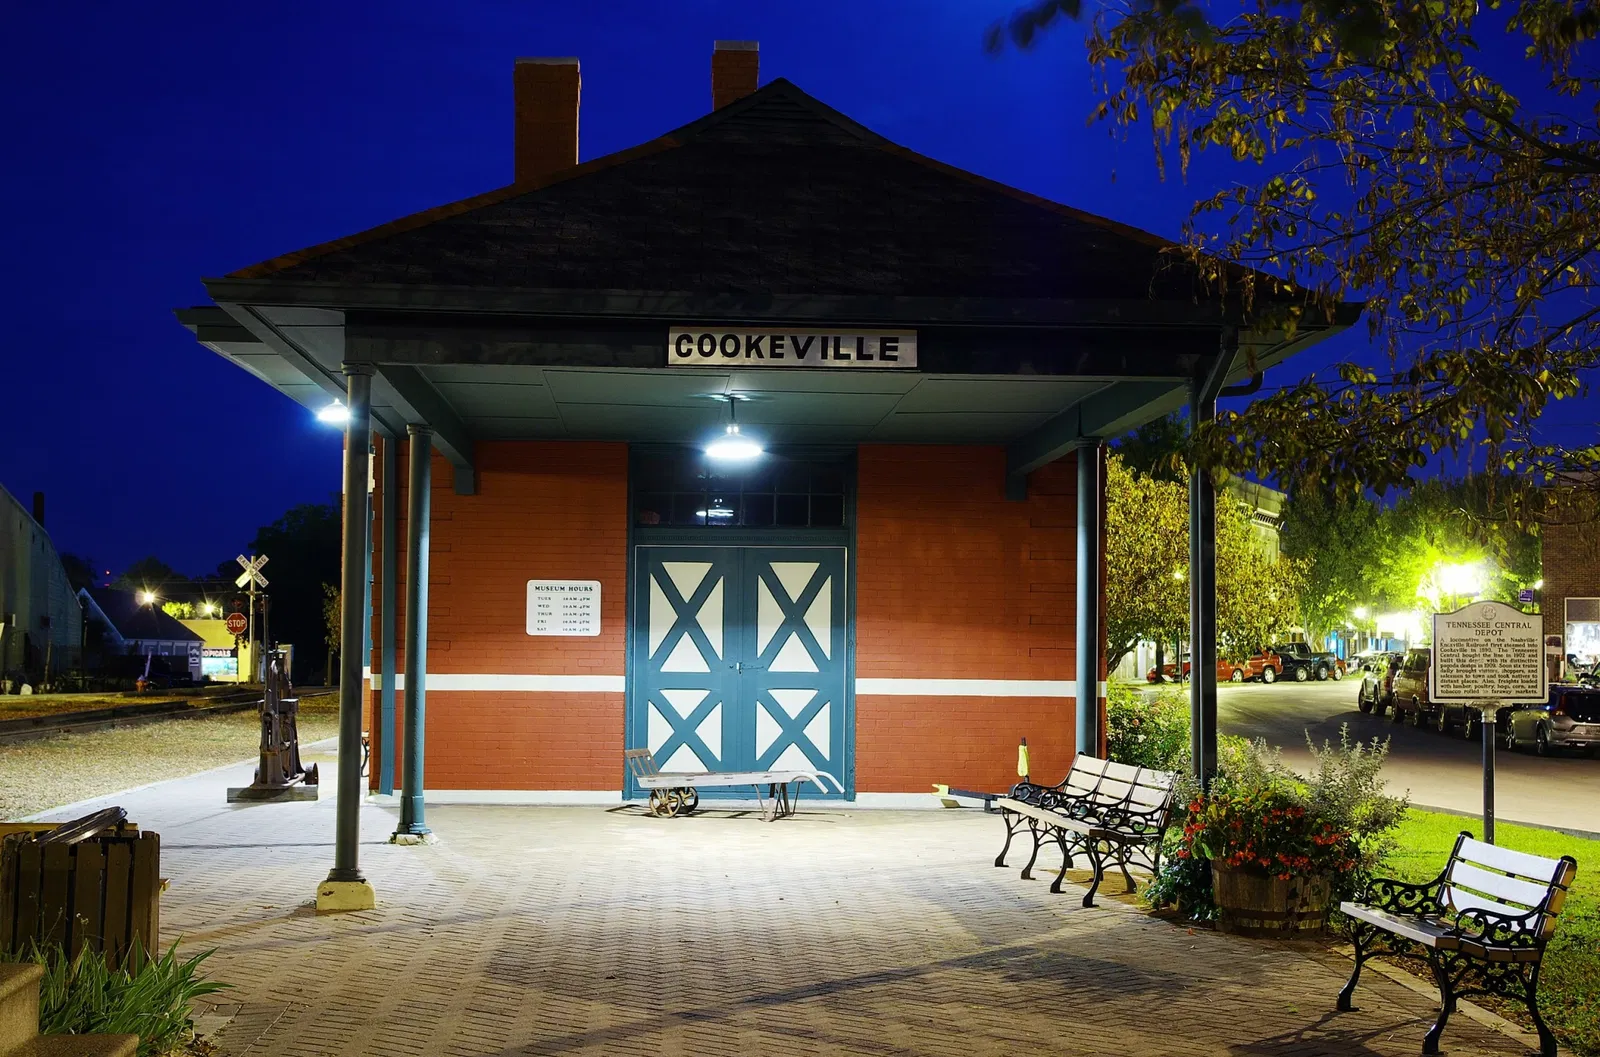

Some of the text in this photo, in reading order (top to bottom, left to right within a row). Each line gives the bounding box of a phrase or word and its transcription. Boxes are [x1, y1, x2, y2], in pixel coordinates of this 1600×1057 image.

[675, 333, 899, 361] COOKEVILLE
[228, 619, 246, 628] STOP
[1446, 621, 1532, 629] TENNESSEE CENTRAL
